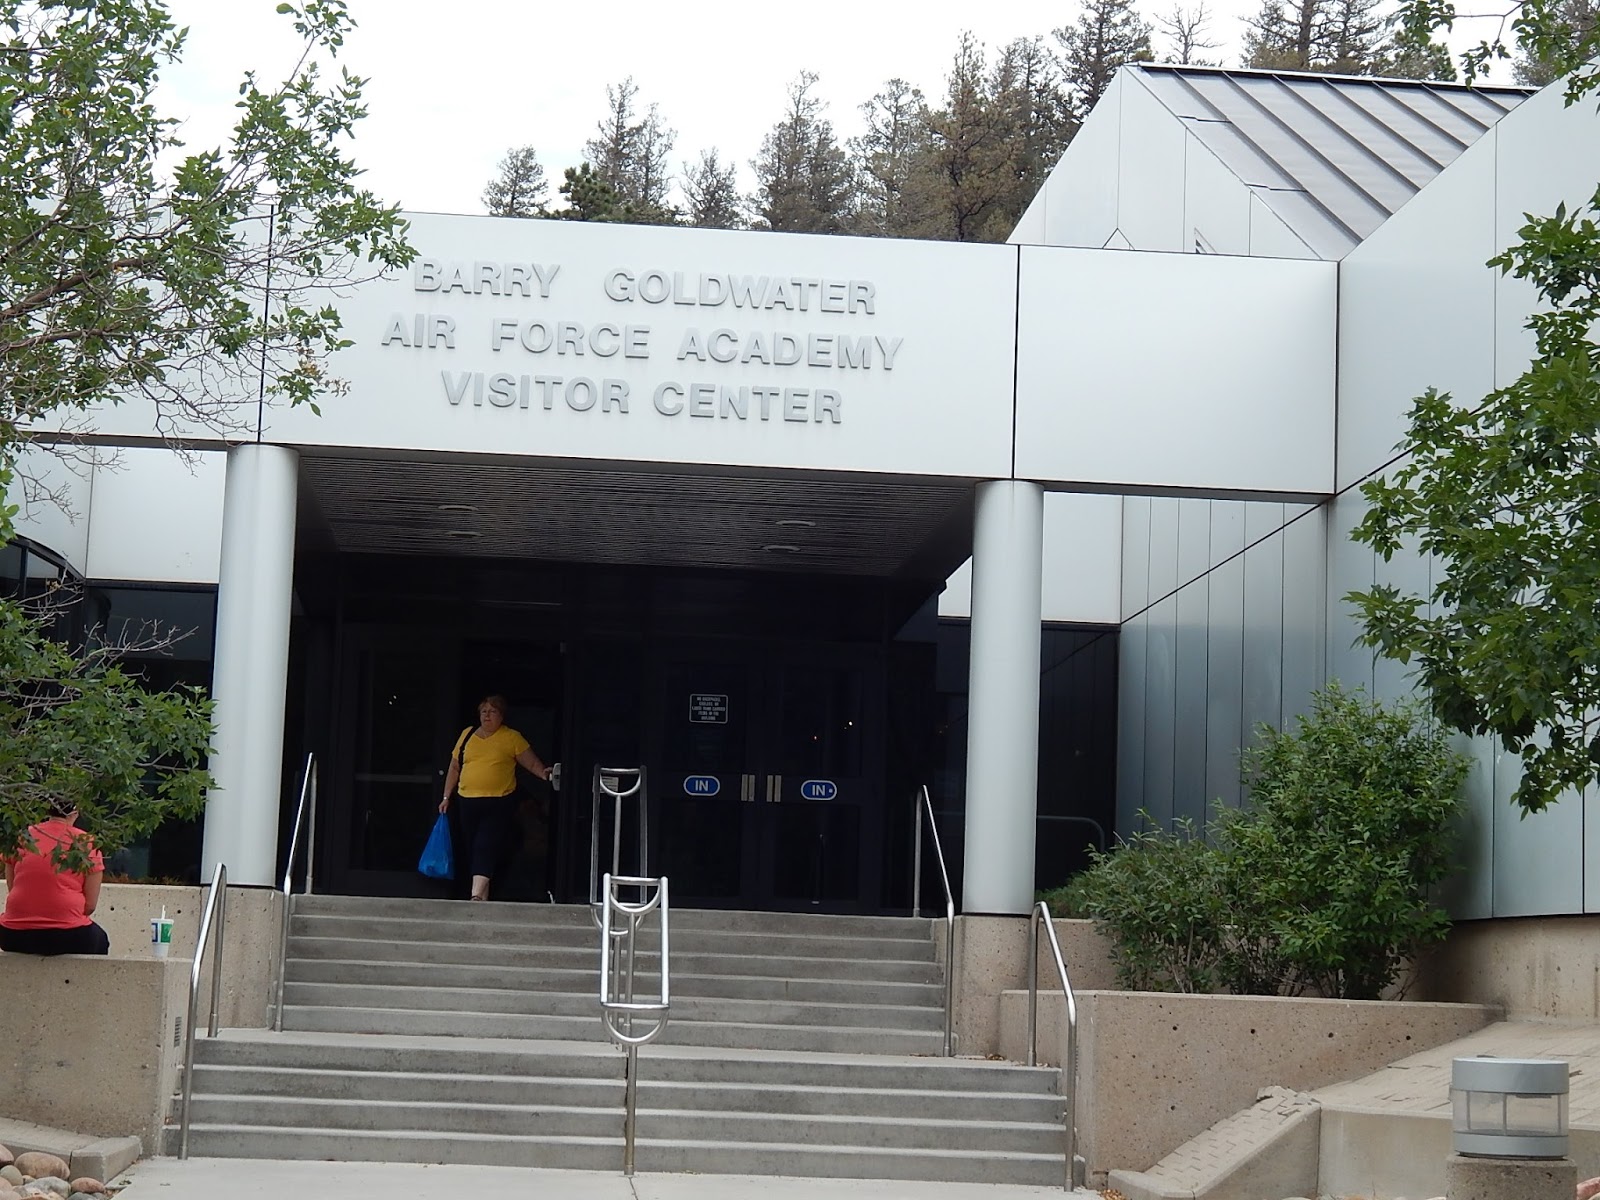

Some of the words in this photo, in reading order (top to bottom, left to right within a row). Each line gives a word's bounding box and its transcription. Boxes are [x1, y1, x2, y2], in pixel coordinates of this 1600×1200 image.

[414, 257, 560, 297] BARRY
[604, 267, 877, 314] GOLDWATER
[381, 313, 456, 348] AIR
[491, 318, 651, 358] FORCE
[677, 328, 904, 370] ACADEMY
[441, 370, 630, 413] VISITOR
[653, 381, 842, 423] CENTER
[694, 780, 709, 792] IN
[811, 785, 826, 796] IN
